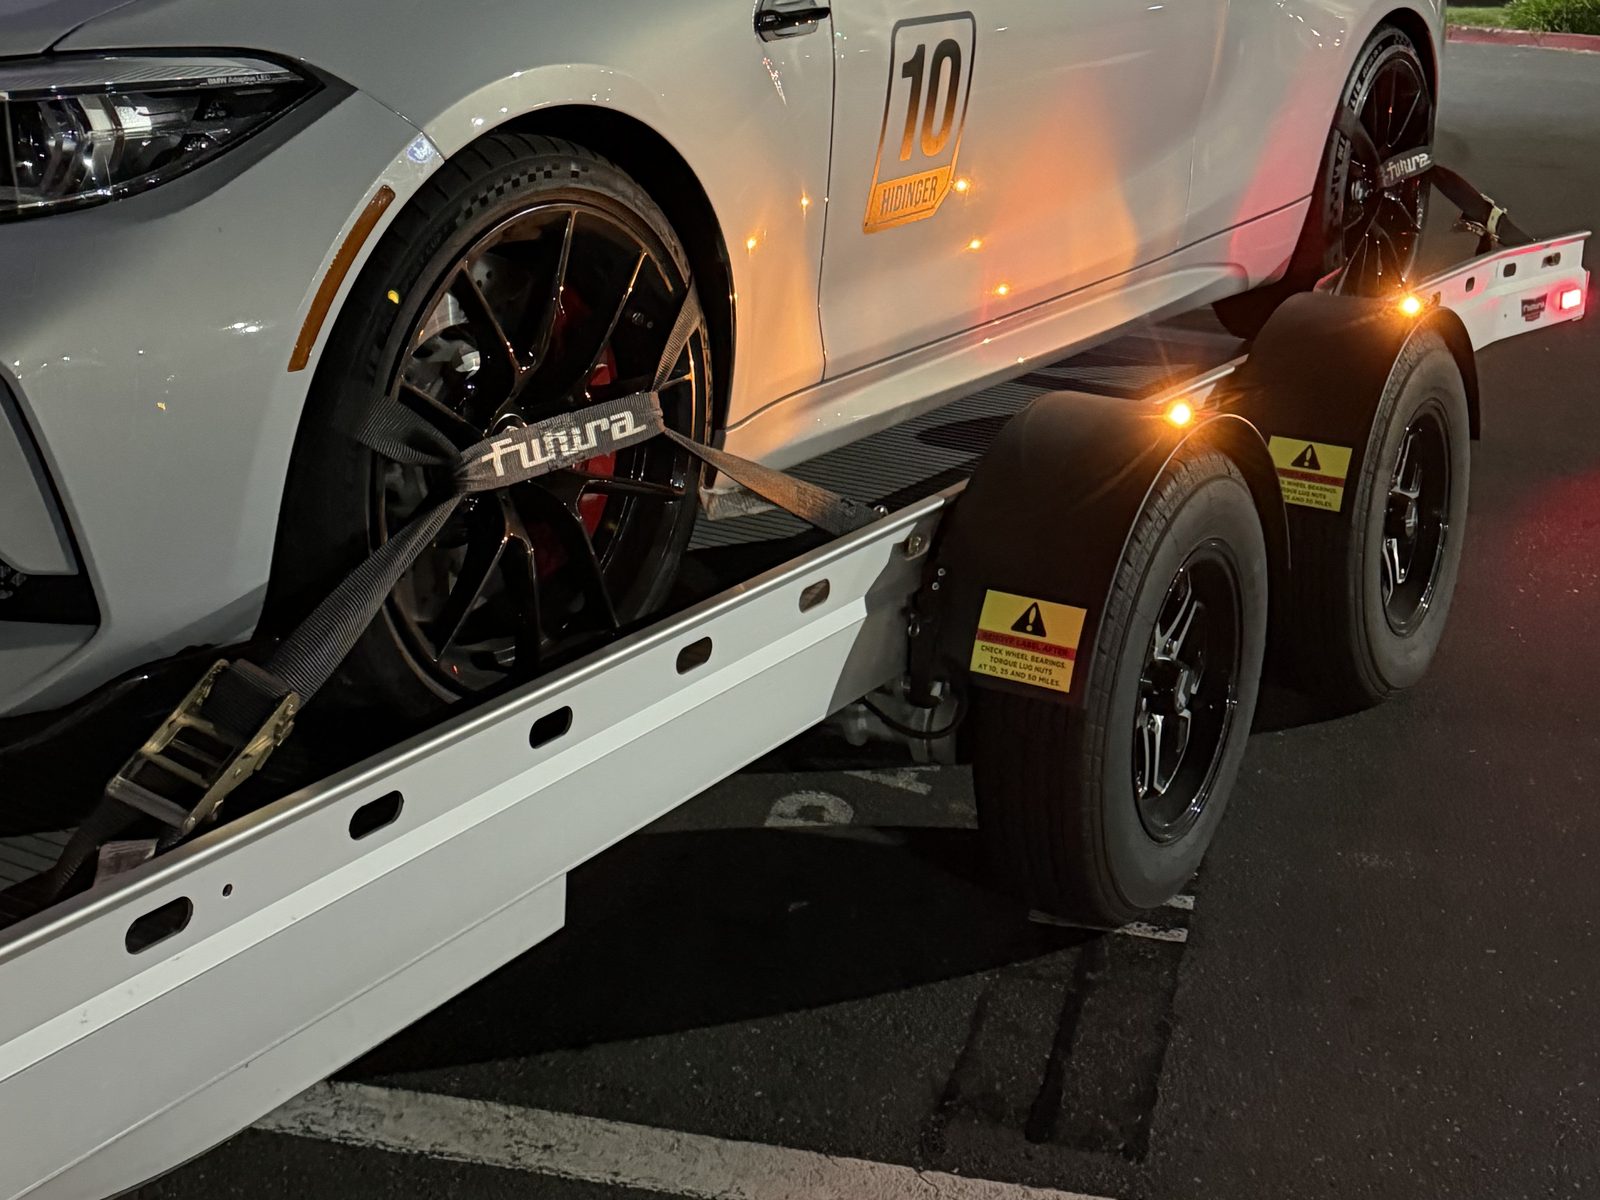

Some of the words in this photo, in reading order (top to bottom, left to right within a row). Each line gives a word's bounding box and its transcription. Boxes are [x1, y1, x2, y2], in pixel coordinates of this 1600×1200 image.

[900, 38, 961, 161] 10
[880, 175, 938, 216] HIDINGER
[980, 644, 1003, 655] CHECK
[1005, 649, 1028, 661] WHEEL
[978, 663, 988, 671] AT
[1010, 670, 1026, 679] AND
[990, 656, 1018, 668] TORQUE
[1019, 662, 1033, 672] LUG
[1034, 666, 1053, 676] NUTS
